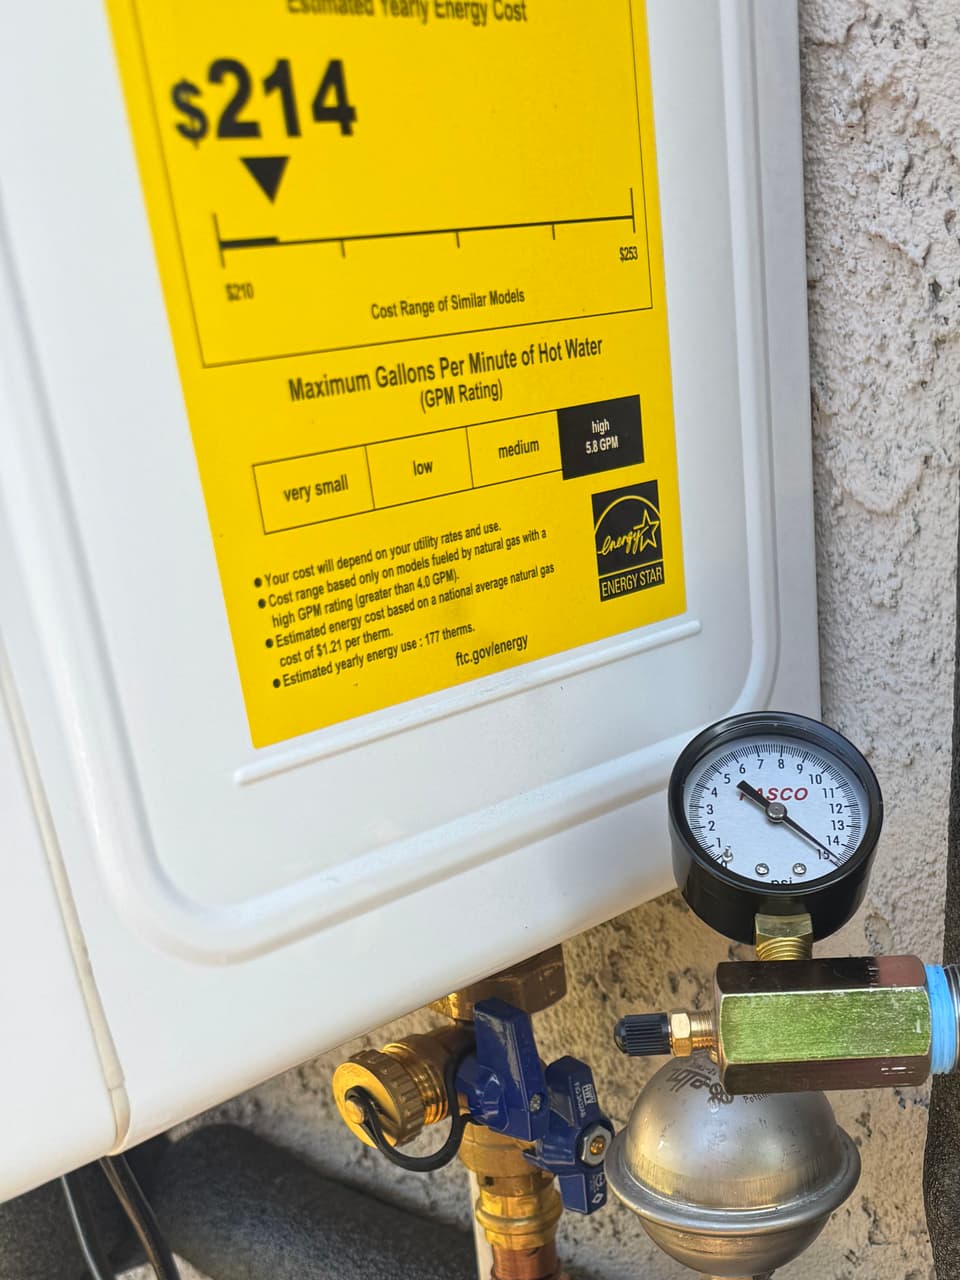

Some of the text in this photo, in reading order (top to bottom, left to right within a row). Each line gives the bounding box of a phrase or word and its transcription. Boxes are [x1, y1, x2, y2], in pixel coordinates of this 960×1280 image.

[382, 0, 428, 25] Yearly
[434, 0, 488, 27] Energy
[493, 0, 527, 22] Cost
[170, 57, 357, 149] $214
[619, 246, 639, 262] $253
[371, 287, 526, 320] Cost Range of Similar Models
[288, 338, 602, 402] Maximum Gallons Per Minute of Hot Water
[420, 378, 503, 414] (GPM Rating)
[591, 418, 610, 435] high
[498, 439, 540, 459] medium
[585, 435, 619, 455] 5.8 GPM
[412, 460, 433, 476] low
[283, 473, 349, 503] very small
[598, 530, 642, 556] energy
[264, 522, 501, 587] Your cost will depend on your utility rates and use.
[268, 529, 547, 608] Cost range based only on models fueled by natural gas with a
[601, 566, 662, 597] ENERGY STAR
[271, 611, 296, 628] high
[297, 603, 323, 621] GPM
[324, 598, 353, 614] rating
[355, 587, 392, 609] (greater
[394, 581, 415, 596] than
[416, 575, 431, 589] 4.0
[275, 563, 555, 648] Estimated energy cost based on a national average natural gas
[279, 627, 394, 667] cost of $1.21 per therm.
[282, 660, 334, 687] Estimated
[335, 653, 364, 675] yearly
[366, 645, 399, 663] energy
[400, 639, 417, 653] use
[424, 630, 441, 645] 177
[442, 623, 476, 641] therms.
[455, 634, 529, 667] ftc.gov/energy
[738, 763, 746, 774] 6
[758, 759, 764, 769] 7
[778, 759, 785, 769] 8
[796, 763, 804, 774] 9
[723, 773, 731, 784] 5
[809, 773, 823, 785] 10
[711, 787, 718, 797] 4
[739, 787, 808, 801] ASCO
[822, 788, 835, 798] 11
[706, 804, 714, 815] 3
[829, 803, 843, 815] 12
[708, 821, 716, 832] 2
[831, 819, 846, 831] 13
[716, 837, 722, 848] 1
[826, 835, 841, 846] 14
